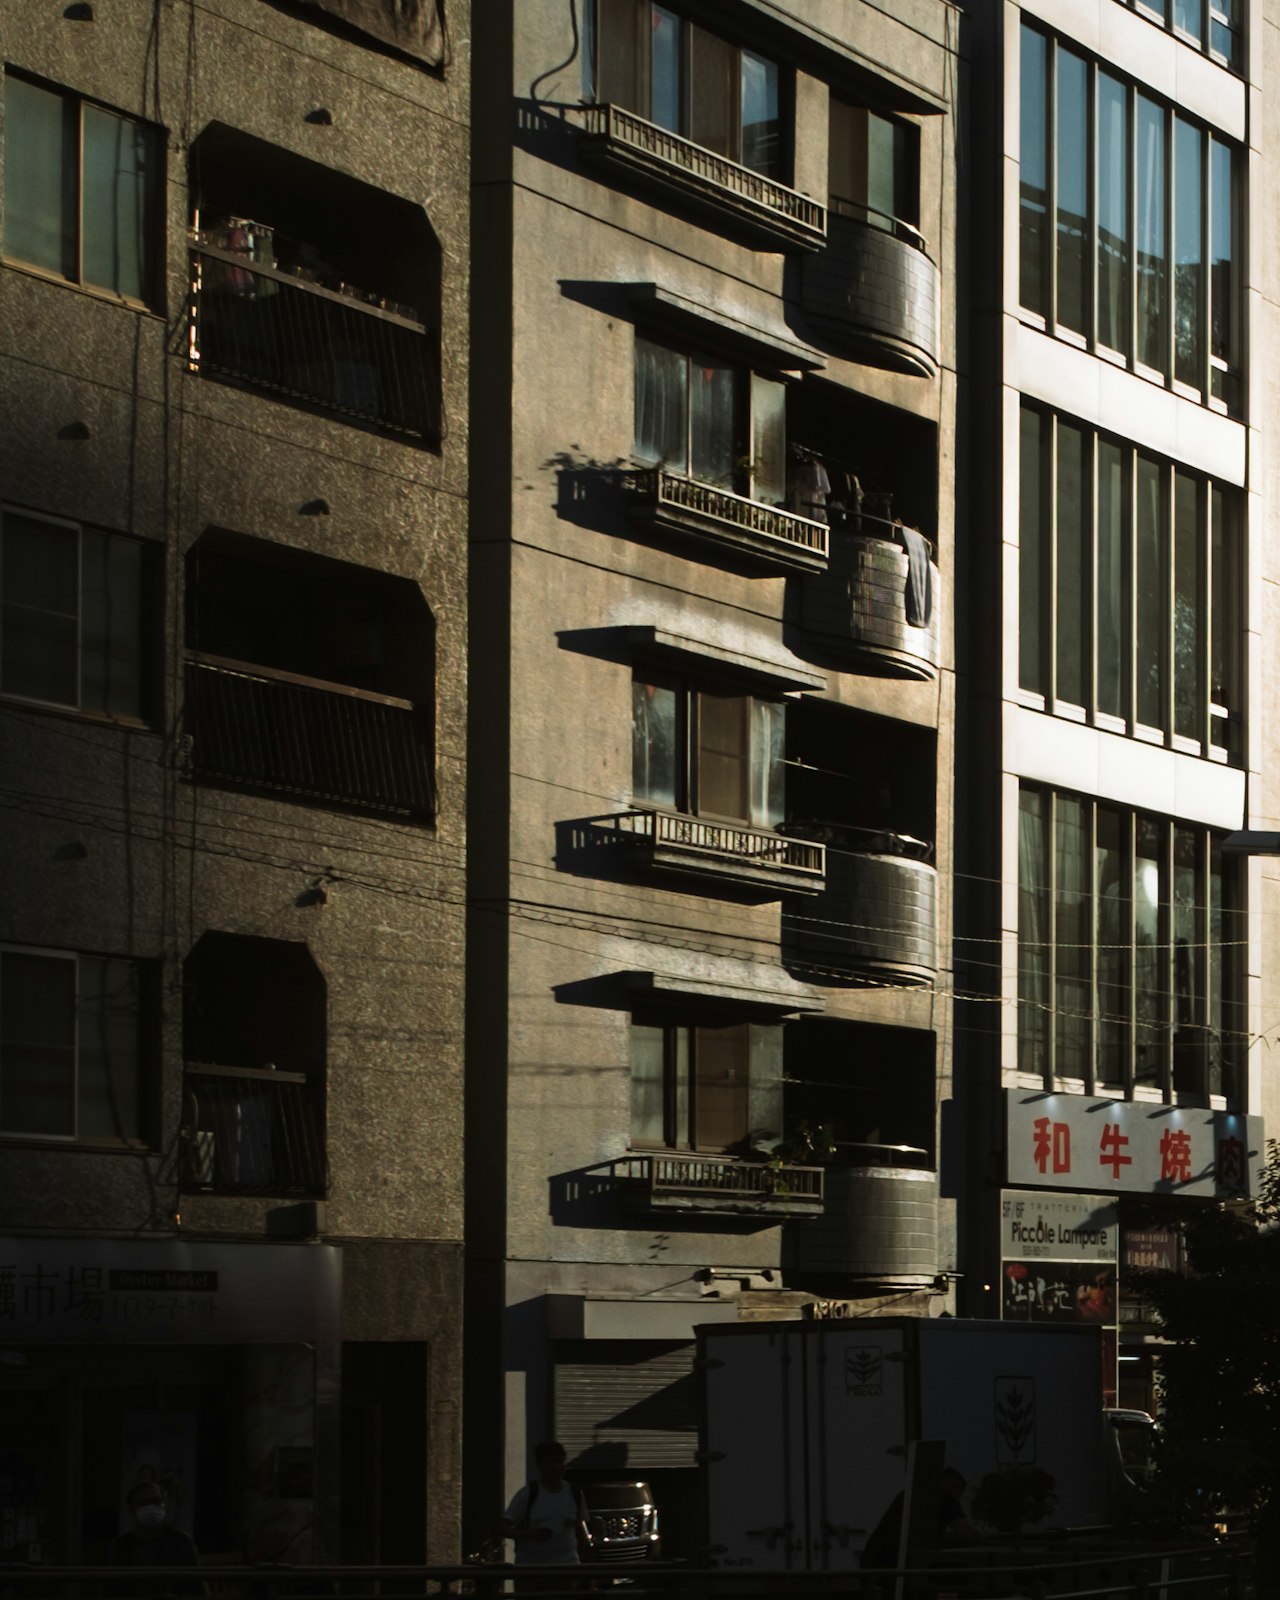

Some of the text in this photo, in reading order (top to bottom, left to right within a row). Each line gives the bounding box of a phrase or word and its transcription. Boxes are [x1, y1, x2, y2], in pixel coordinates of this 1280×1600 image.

[1030, 1203, 1089, 1213] TRATTORIA
[1011, 1219, 1055, 1244] Piccole
[119, 1272, 208, 1287] Oyster Market
